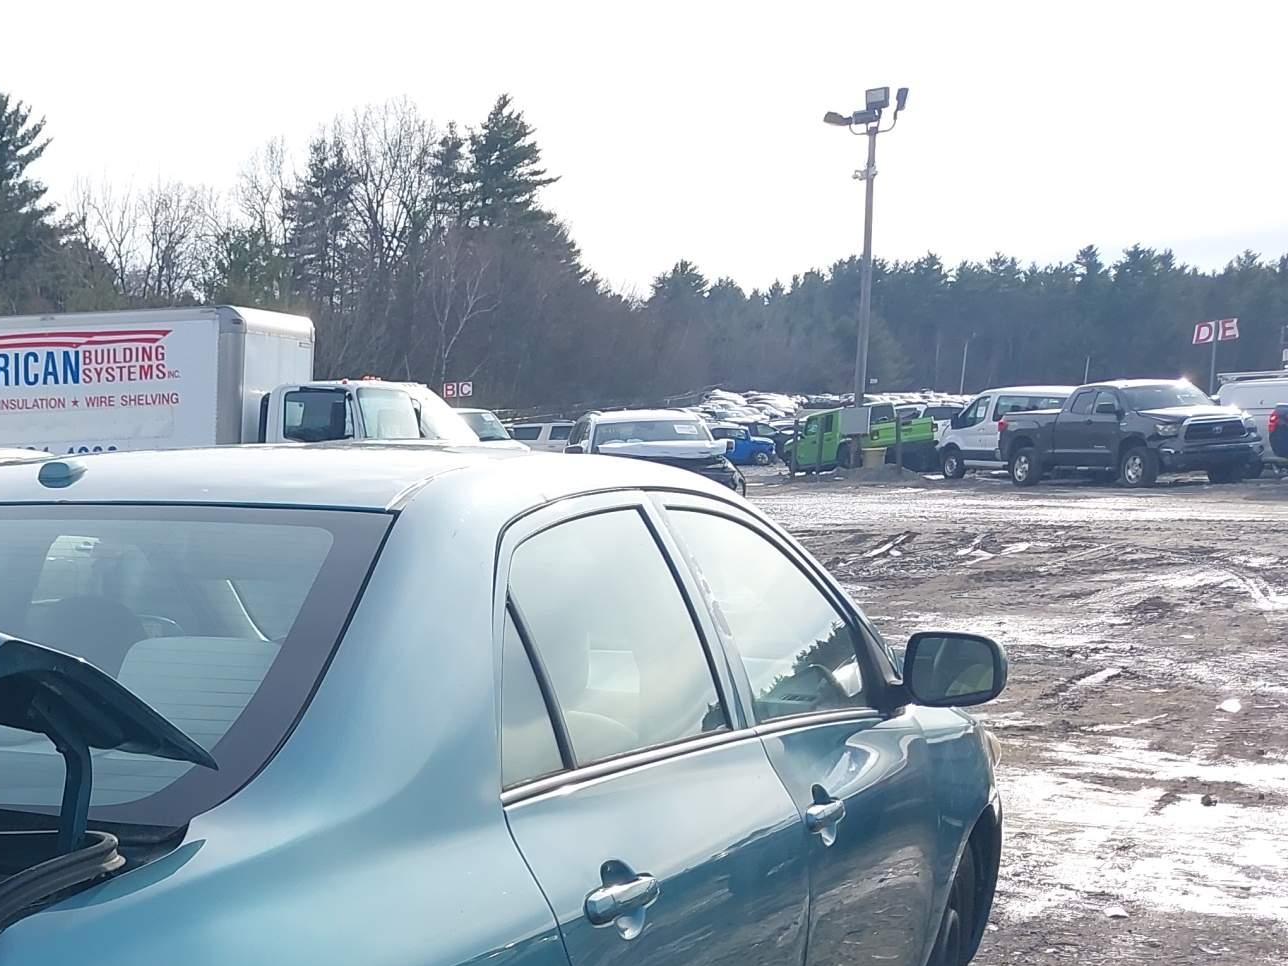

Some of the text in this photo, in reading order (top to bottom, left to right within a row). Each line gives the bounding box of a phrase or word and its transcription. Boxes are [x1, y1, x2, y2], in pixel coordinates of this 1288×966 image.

[83, 345, 165, 366] BUILDING
[82, 363, 166, 384] SYSTEMS
[445, 383, 471, 397] B C
[85, 395, 115, 408] WIRE
[120, 392, 179, 407] SHELVING
